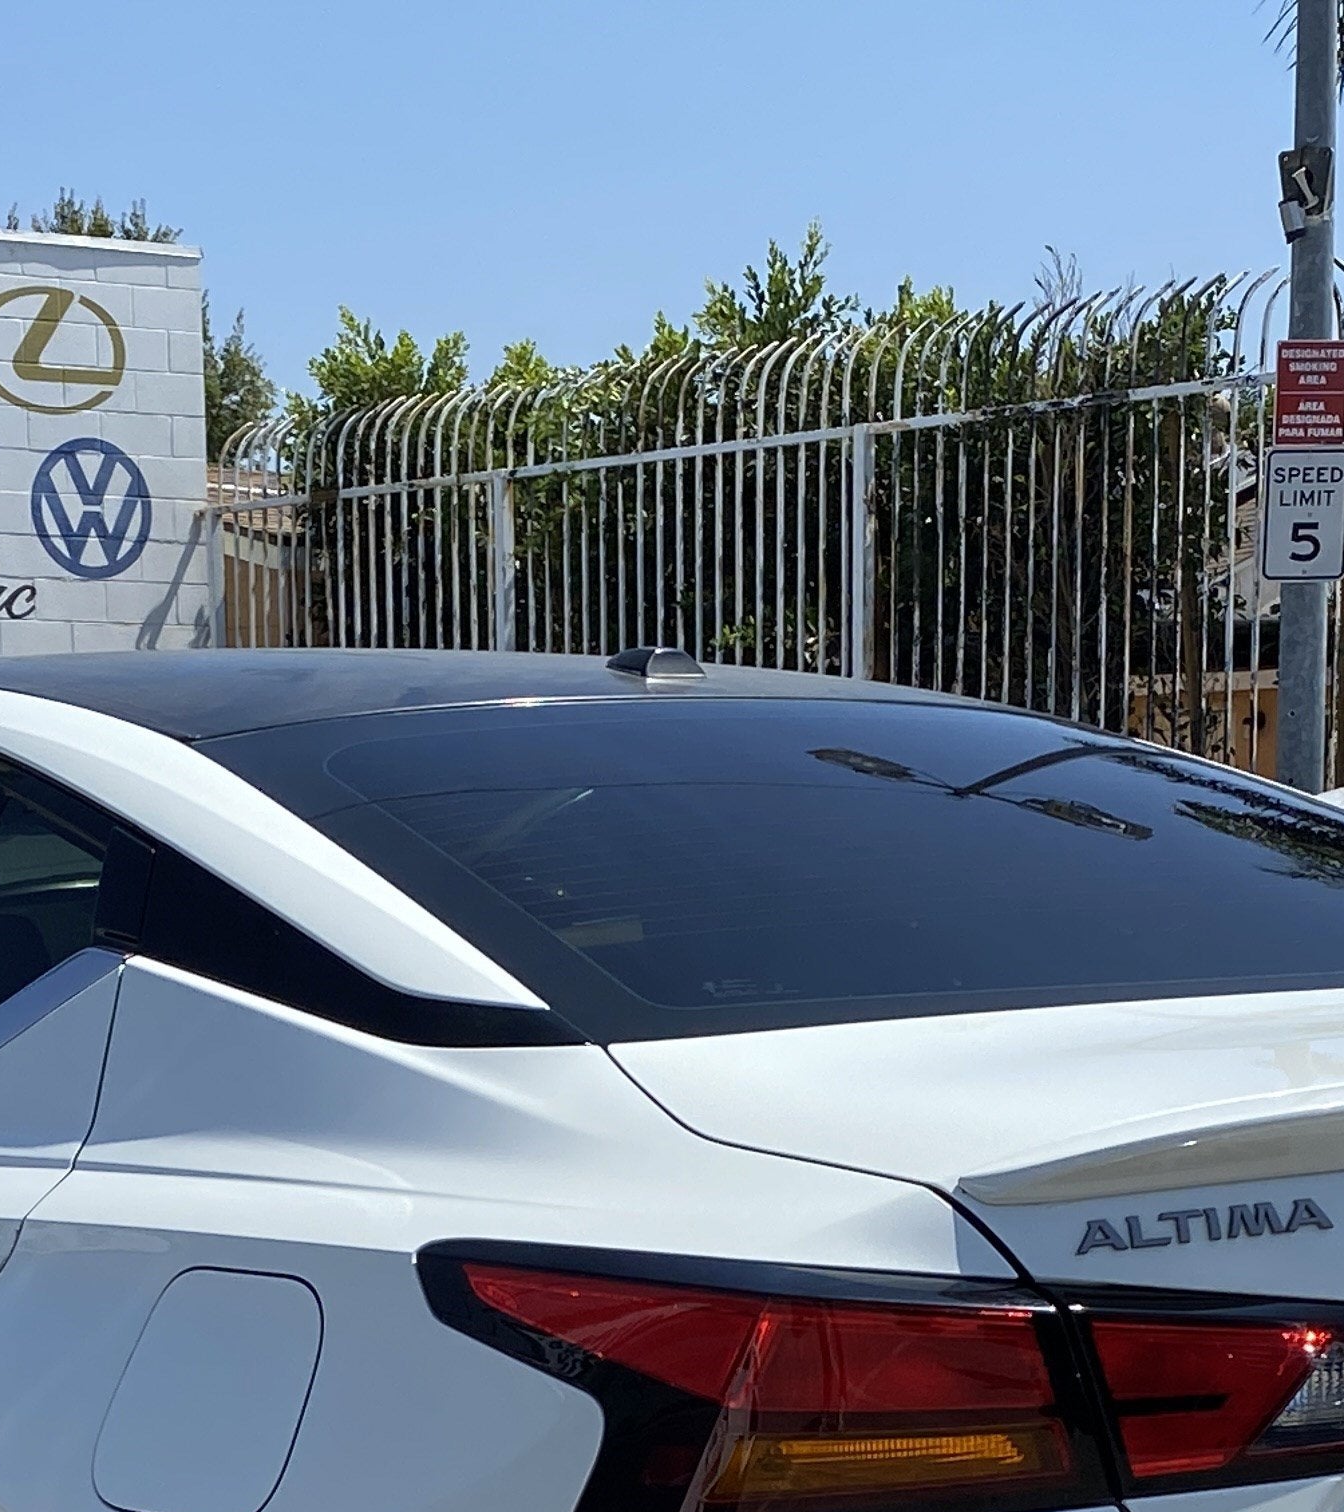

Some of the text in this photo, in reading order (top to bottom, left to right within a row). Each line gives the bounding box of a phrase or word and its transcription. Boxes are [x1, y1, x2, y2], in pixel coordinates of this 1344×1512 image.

[1288, 361, 1337, 372] SMOKING
[1298, 374, 1328, 385] AREA
[1281, 414, 1341, 424] DESIGNADA
[1278, 427, 1343, 438] PARA FUMAR
[1273, 466, 1344, 484] SPEED
[1279, 489, 1336, 508] LIMIT
[1289, 521, 1321, 562] 5
[1075, 1197, 1334, 1256] ALTIMA
